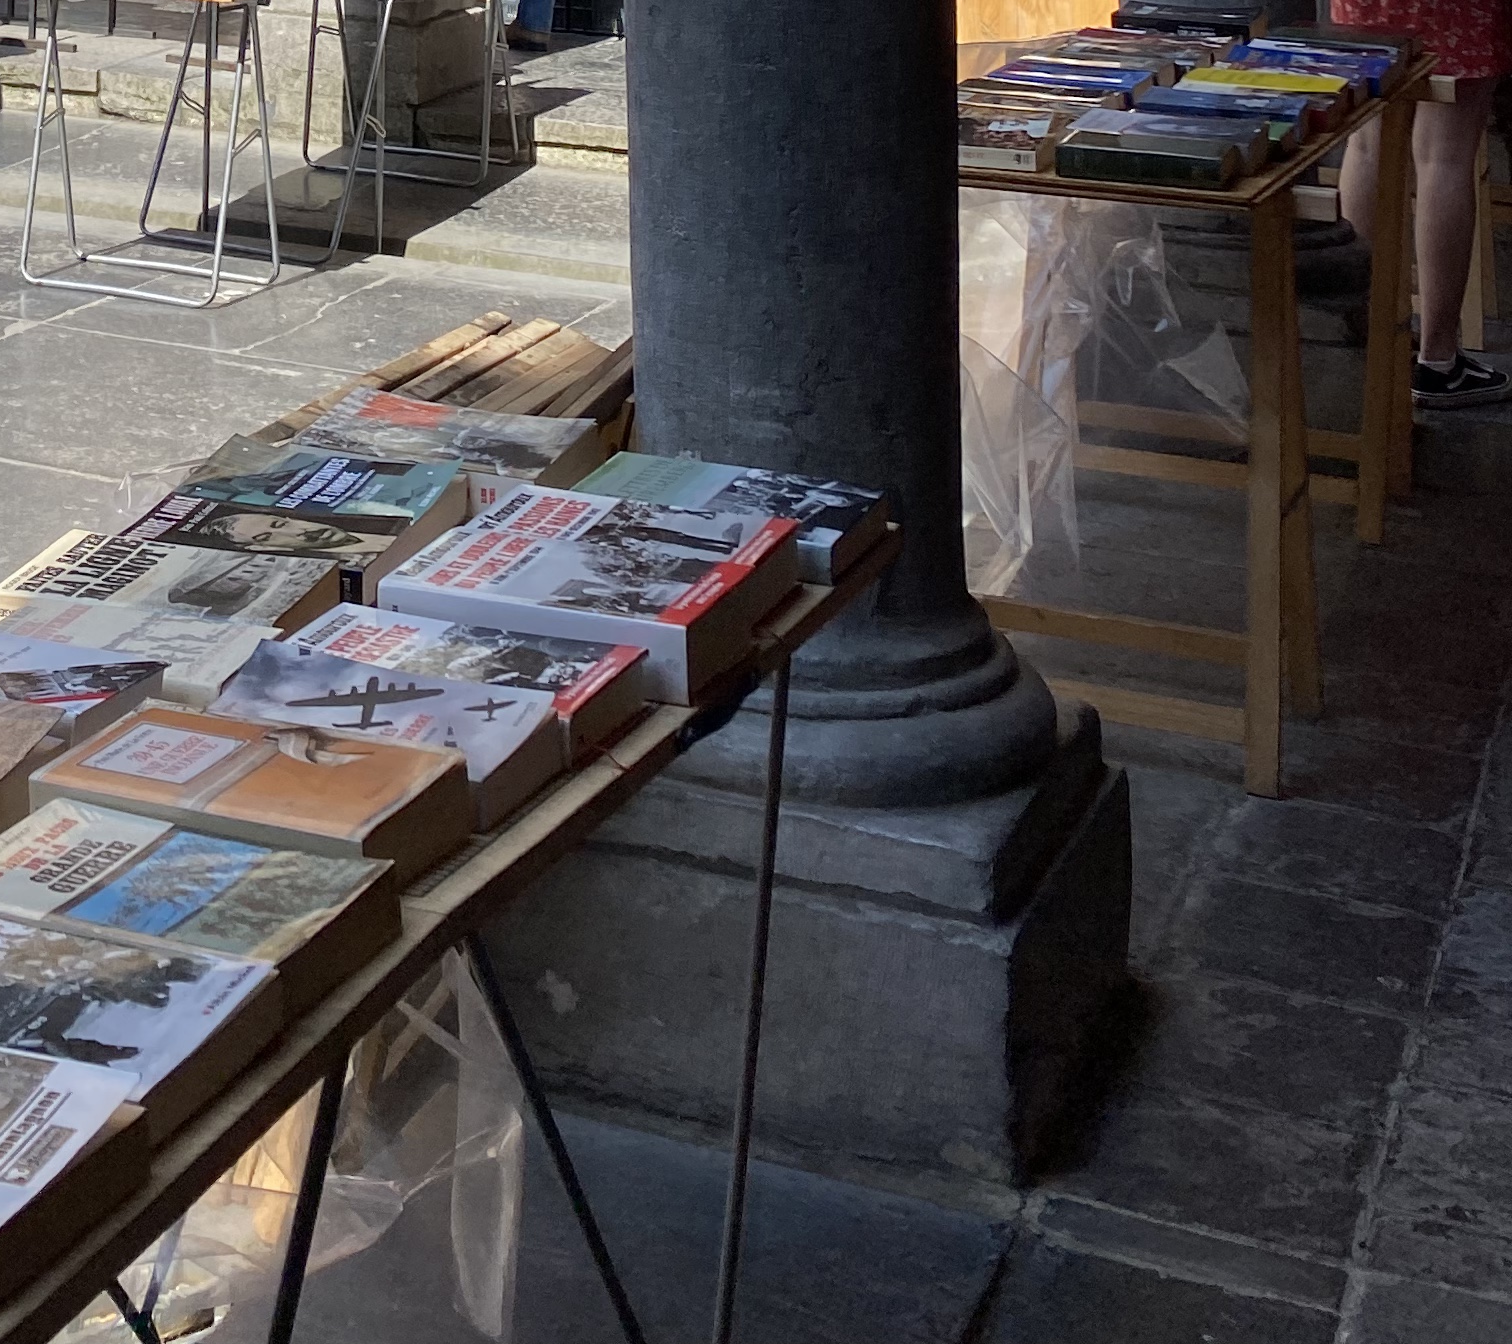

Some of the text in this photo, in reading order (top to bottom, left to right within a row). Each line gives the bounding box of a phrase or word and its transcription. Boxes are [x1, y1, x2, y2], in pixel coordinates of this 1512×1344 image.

[507, 495, 566, 532] PASSIONS
[544, 499, 594, 527] HAINES
[15, 534, 109, 593] FAITES SAUTER
[39, 536, 146, 598] LA LIGNE
[75, 548, 169, 601] MAGINOT
[446, 560, 473, 571] ET
[324, 623, 383, 655] PEUPLE
[21, 843, 70, 871] DE LA
[29, 838, 105, 884] GRANDE
[48, 840, 139, 894] GUERRE
